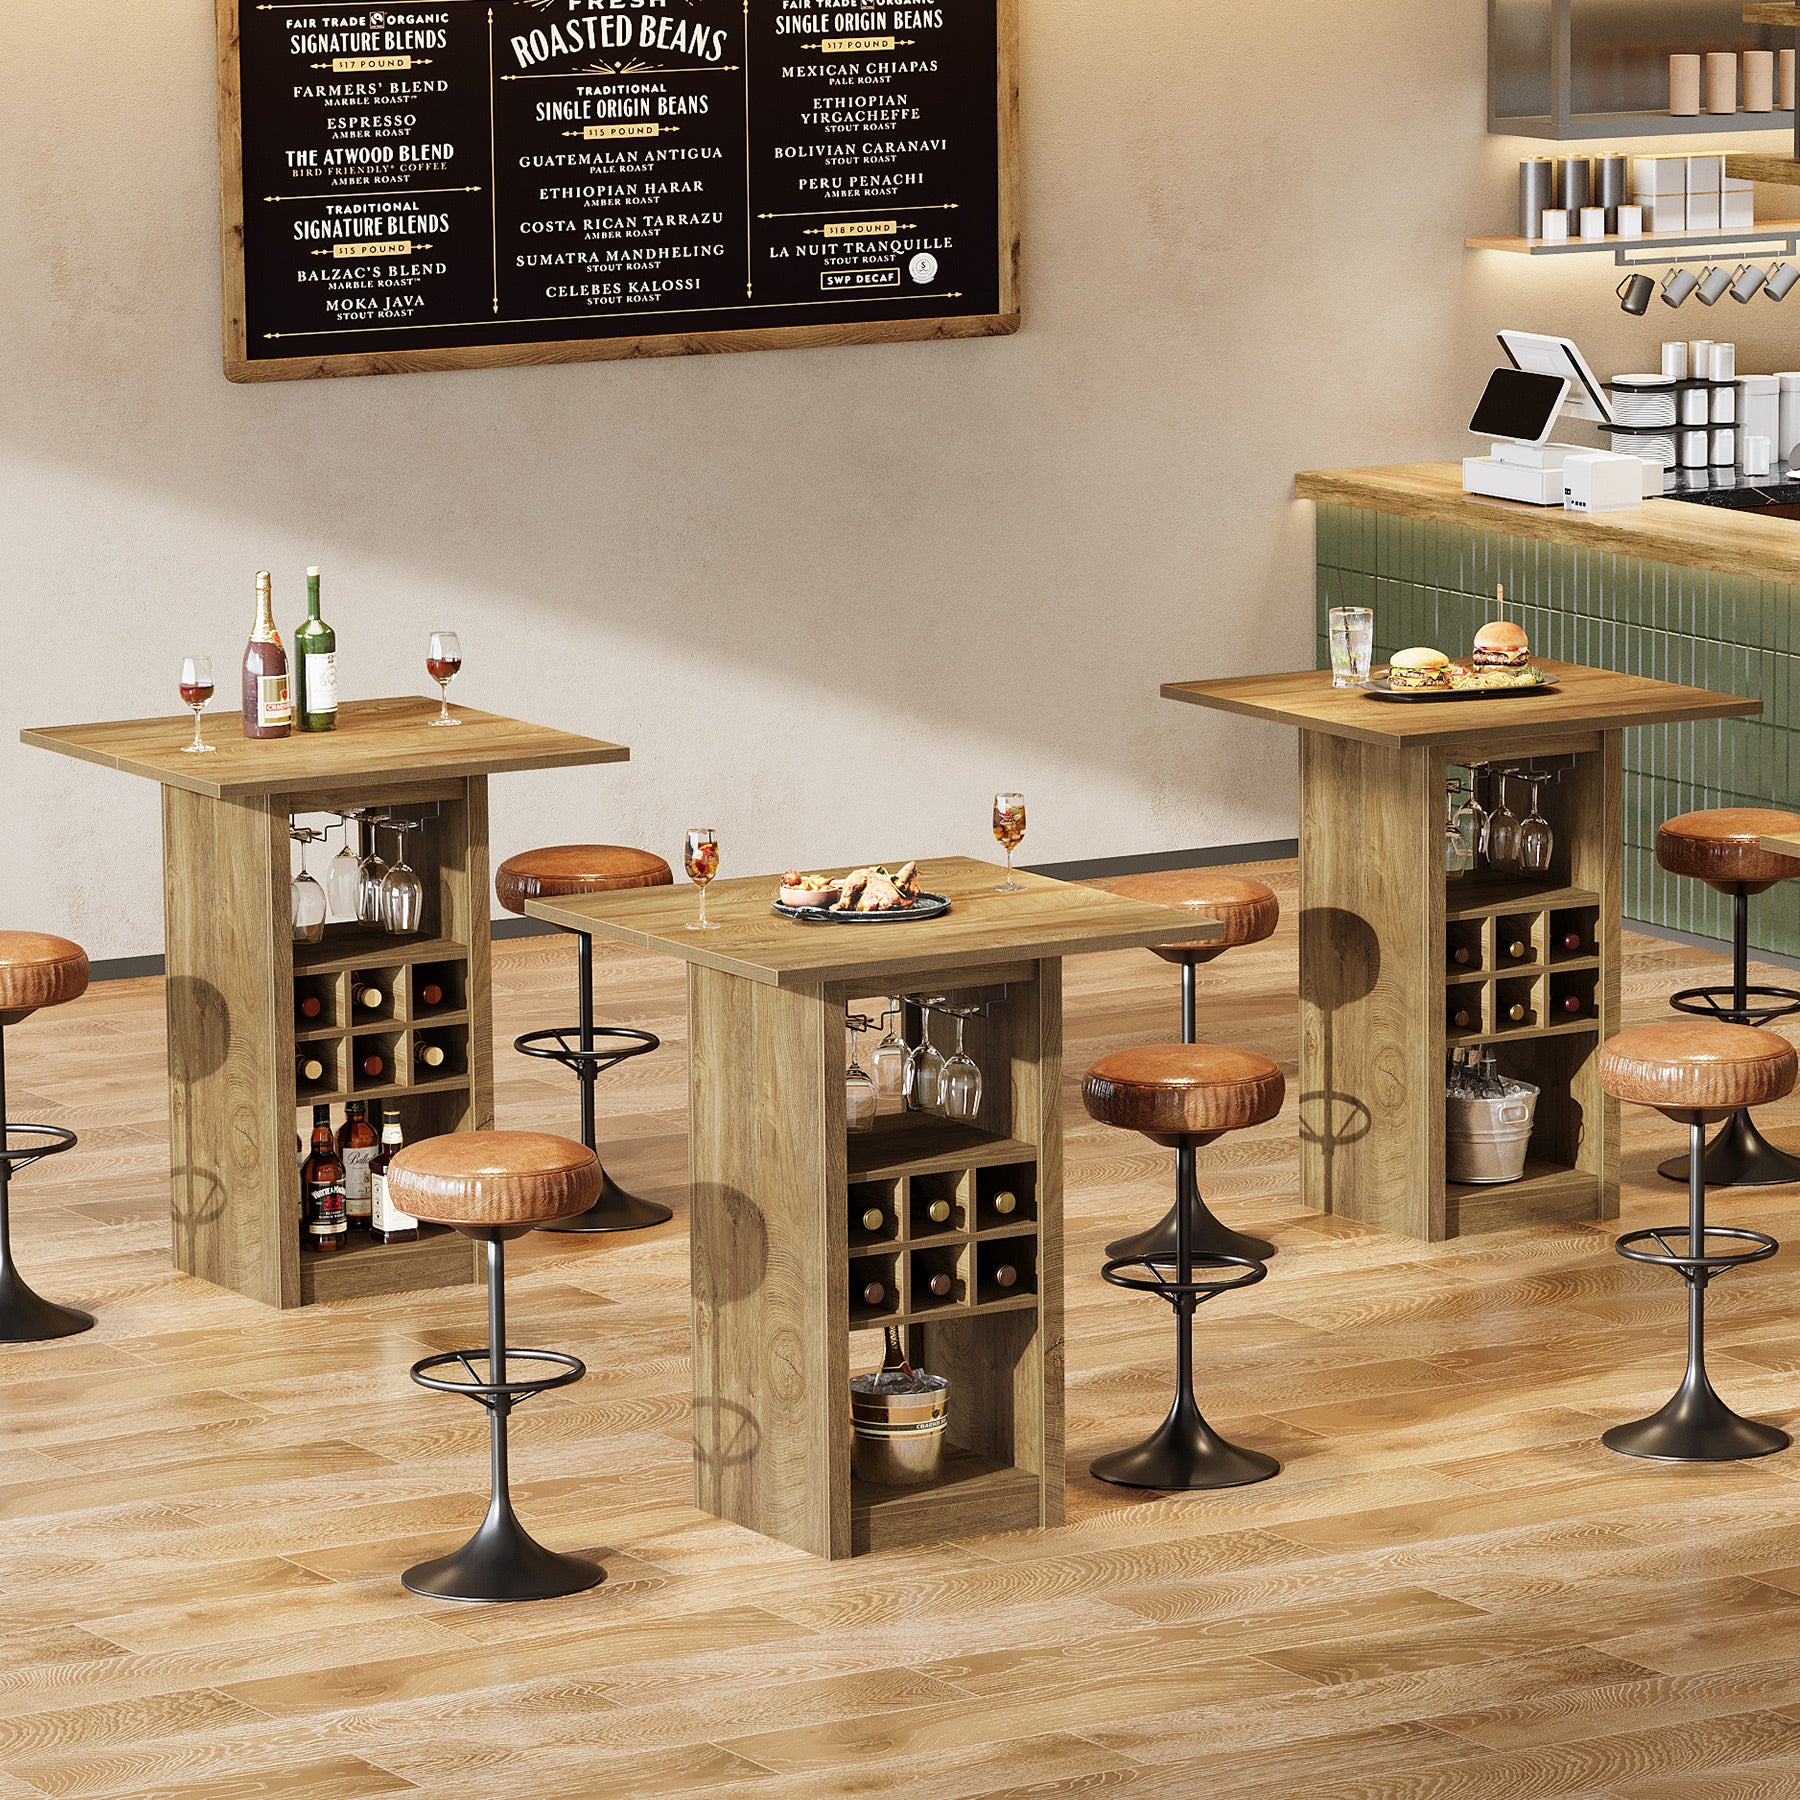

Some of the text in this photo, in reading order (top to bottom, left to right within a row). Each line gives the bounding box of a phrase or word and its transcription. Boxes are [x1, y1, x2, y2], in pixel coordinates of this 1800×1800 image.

[782, 0, 811, 10] FAIR
[818, 0, 857, 8] TRADE
[286, 13, 449, 29] FAIR TRADE ORGANIC
[776, 9, 943, 35] SINGLE ORIGIN BEANS
[290, 29, 447, 54] SIGNATURE BLENDS
[510, 15, 728, 68] ROASTED BEANS
[847, 40, 888, 48] POUND
[360, 59, 404, 68] POUND
[782, 60, 938, 78] MEXICAN CHIAPAS
[829, 75, 892, 86] PALE ROAST
[293, 80, 448, 97] FARMERS' BLEND
[577, 84, 666, 96] TRADITIONAL
[324, 97, 370, 106] MARBLE
[536, 95, 708, 121] SINGLE ORIGIN BEANS
[813, 95, 908, 109] ETHIOPIAN
[327, 114, 417, 129] ESPRESSO
[801, 108, 920, 124] YIRGACHEFFE
[332, 128, 411, 139] AMBER ROAST
[611, 127, 653, 135] POUND
[824, 123, 897, 133] STOUT ROAST
[285, 143, 454, 167] THE ATWOOD BLEND
[774, 139, 946, 158] BOLIVIAN CARANAVI
[519, 147, 723, 168] GUATEMALAN ANTIGUA
[825, 155, 897, 165] STOUT ROAST
[292, 168, 322, 177] BIRD
[400, 162, 448, 171] COFFEE
[589, 164, 654, 174] PALE ROAST
[331, 175, 410, 186] AMBER ROAST
[799, 173, 924, 190] PERU PENACHI
[539, 181, 704, 200] ETHIOPIAN HARAR
[824, 188, 898, 198] AMBER ROAST
[584, 196, 660, 207] AMBER ROAST
[326, 202, 419, 215] TRADITIONAL
[294, 213, 449, 240] SIGNATURE BLENDS
[520, 212, 723, 233] COSTA RICAN TARRAZU
[850, 224, 890, 232] POUND
[584, 229, 661, 240] AMBER ROAST
[339, 244, 405, 254] $15 POUND
[769, 237, 953, 258] LA NUIT TRANQUILLE
[516, 245, 725, 267] SUMATRA MANDHELING
[824, 255, 896, 265] STOUT ROAST
[297, 263, 447, 282] BALZAC'S BLEND
[586, 261, 661, 272] STOUT ROAST
[328, 280, 374, 290] MARBLE
[827, 273, 894, 285] SWP DECAF
[546, 279, 701, 297] CELEBES KALOSSI
[326, 295, 425, 311] MOKA JAVA
[587, 294, 661, 305] STOUT ROAST
[336, 309, 414, 320] STOUT ROAST
